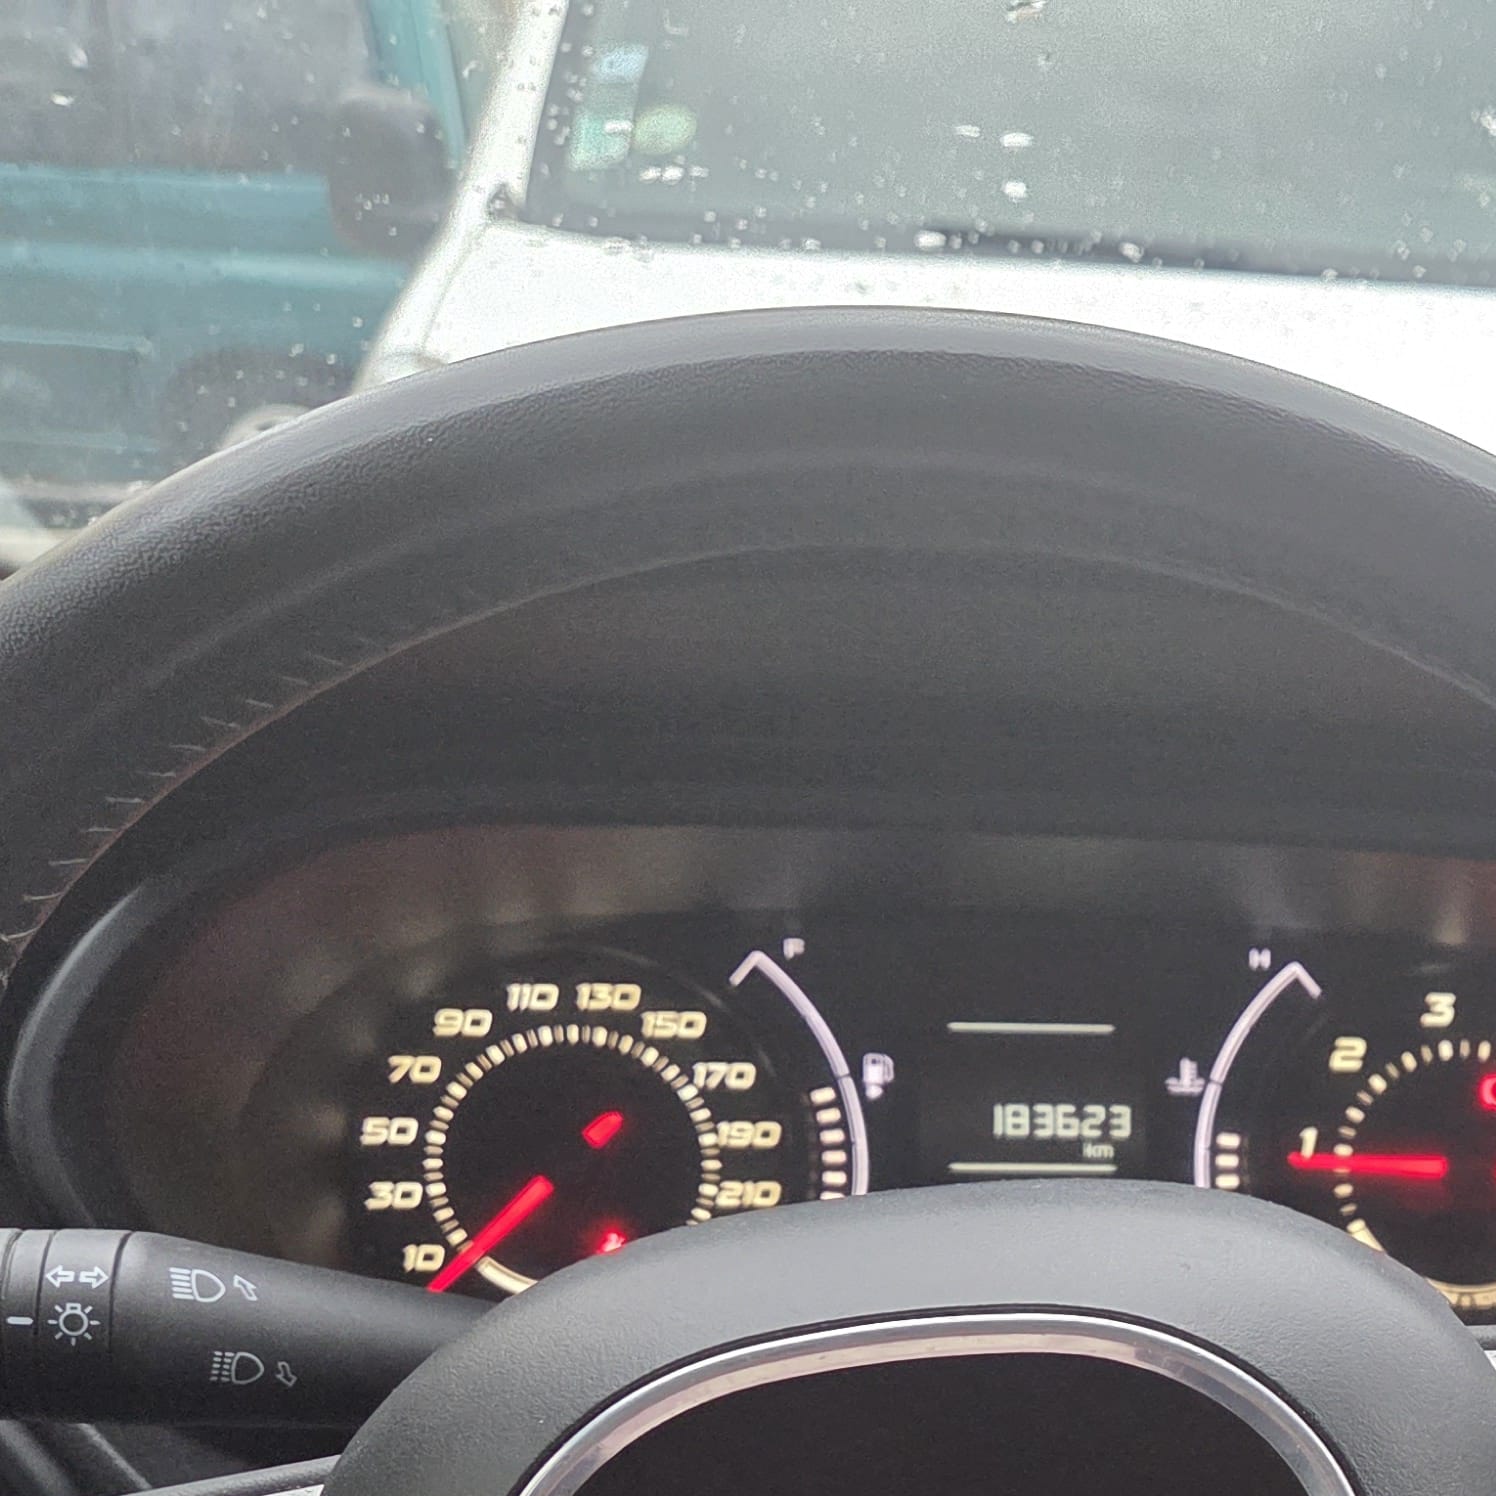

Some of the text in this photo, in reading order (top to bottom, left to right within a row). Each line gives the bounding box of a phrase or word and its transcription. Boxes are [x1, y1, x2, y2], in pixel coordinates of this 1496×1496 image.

[506, 983, 560, 1011] 110
[576, 982, 642, 1011] 130
[1420, 992, 1456, 1027] 3
[433, 1008, 493, 1037] 90
[641, 1010, 707, 1039] 150
[1329, 1036, 1367, 1072] 2
[388, 1055, 442, 1084] 70
[693, 1061, 757, 1090] 170
[359, 1116, 419, 1146] 50
[717, 1121, 782, 1149] 190
[993, 1103, 1132, 1139] 183623
[1082, 1142, 1115, 1159] km
[1298, 1126, 1319, 1161] 1
[364, 1181, 424, 1210] 30
[715, 1180, 782, 1208] 210
[403, 1244, 445, 1272] 10
